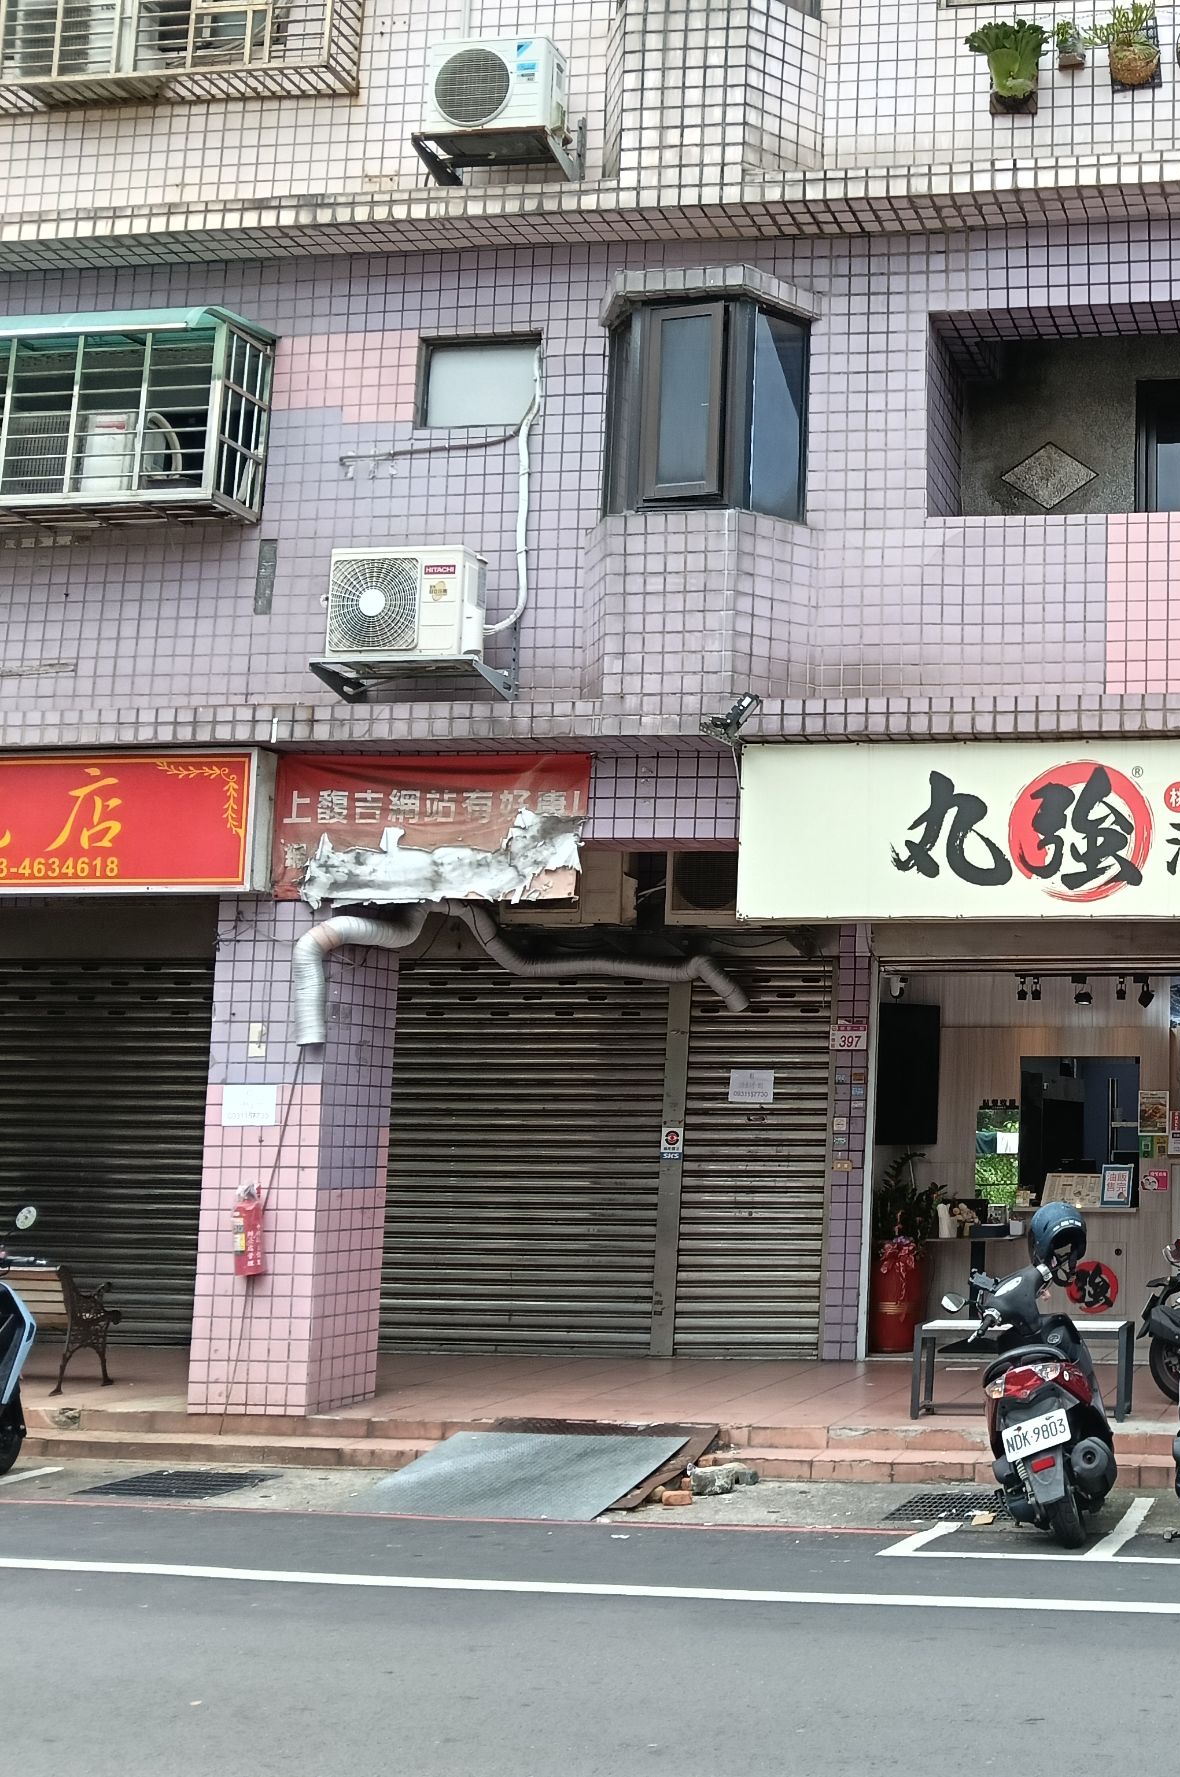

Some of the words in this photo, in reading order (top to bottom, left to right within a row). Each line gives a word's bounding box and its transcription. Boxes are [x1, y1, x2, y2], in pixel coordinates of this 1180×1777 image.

[889, 764, 1142, 890] 丸強
[839, 1035, 862, 1048] 397
[1107, 1172, 1127, 1182] 油飯
